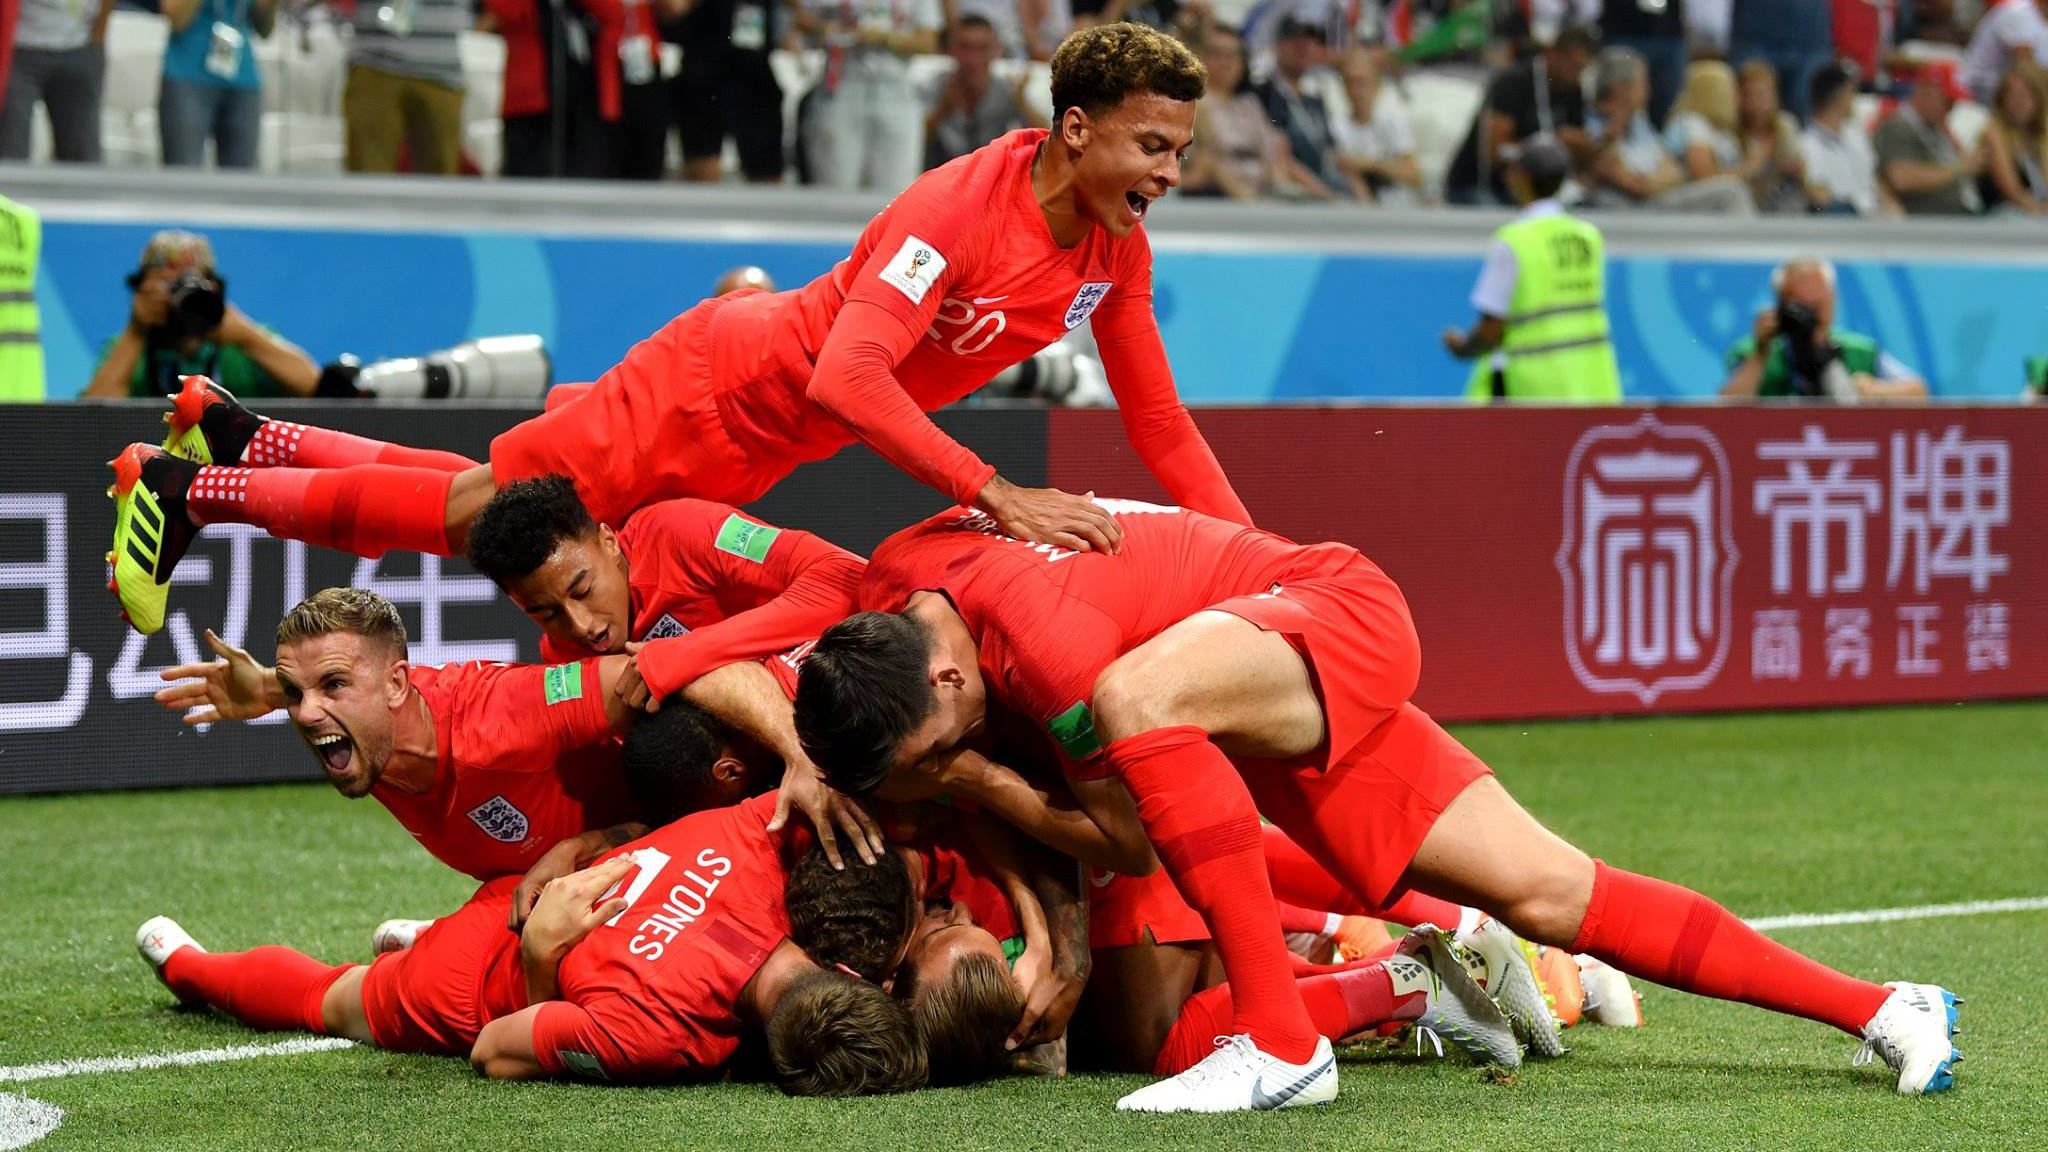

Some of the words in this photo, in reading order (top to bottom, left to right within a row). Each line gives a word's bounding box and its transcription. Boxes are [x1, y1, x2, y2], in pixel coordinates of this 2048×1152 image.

[927, 298, 1007, 355] 20
[1752, 425, 2011, 597] 帝牌
[629, 848, 732, 961] STONES
